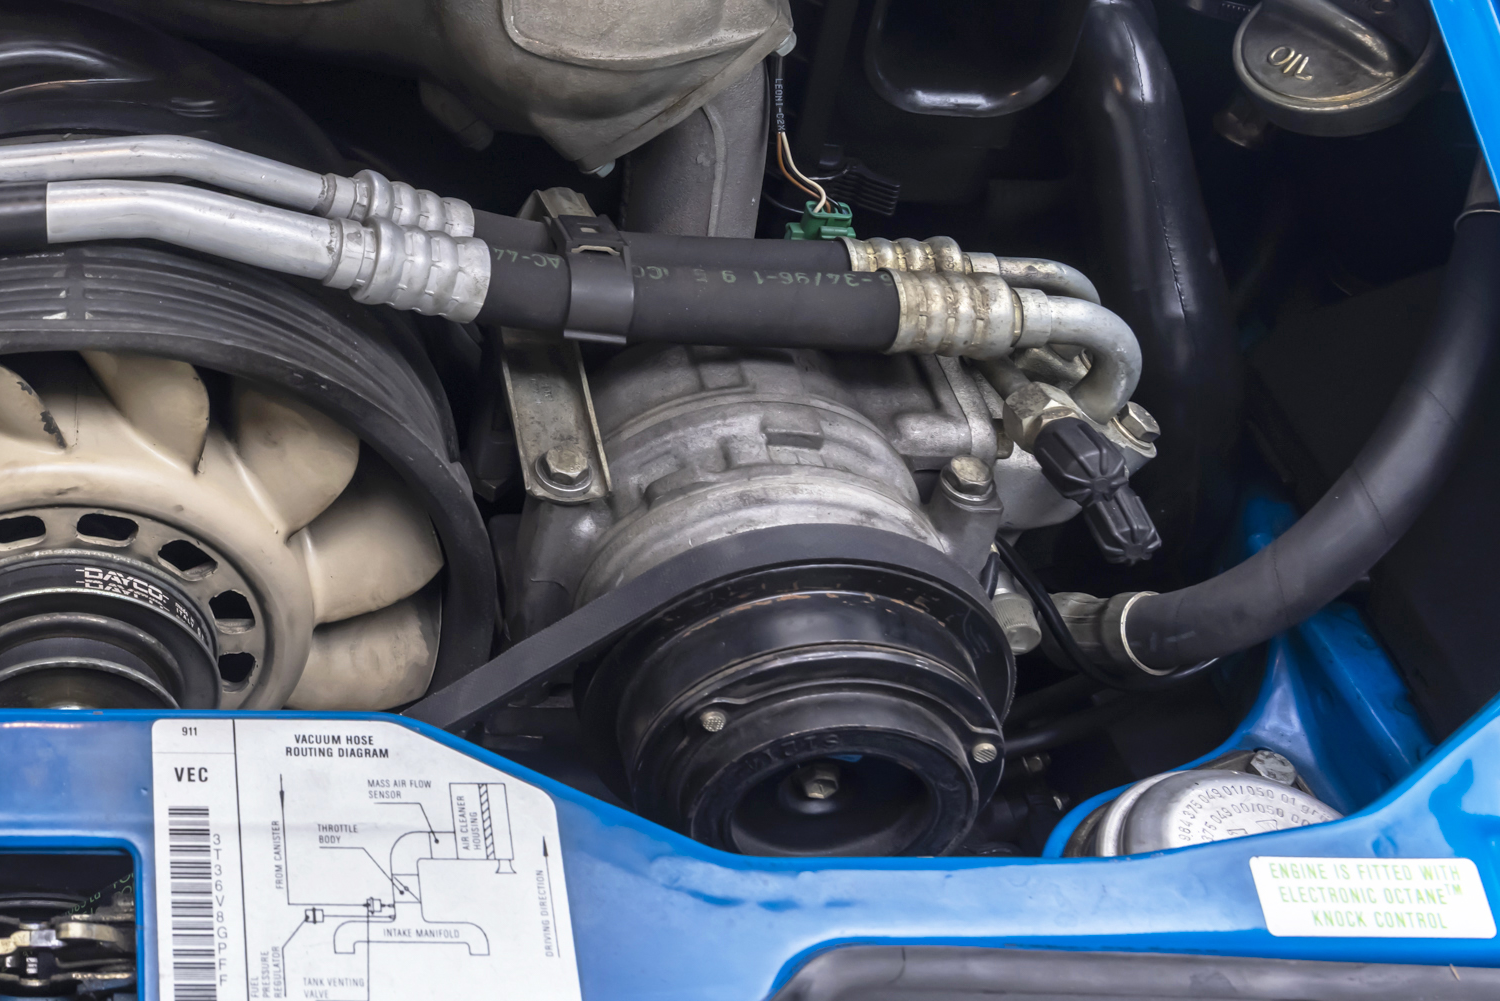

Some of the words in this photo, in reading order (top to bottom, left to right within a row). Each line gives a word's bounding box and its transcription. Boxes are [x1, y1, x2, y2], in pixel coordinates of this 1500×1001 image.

[1267, 46, 1313, 81] OIL
[84, 567, 164, 602] DAYCO
[181, 726, 198, 736] 911
[294, 734, 341, 745] VACUUM
[346, 735, 374, 746] HOSE
[285, 747, 333, 758] ROUTING
[338, 748, 389, 758] DIAGRAM
[174, 767, 208, 783] VEC
[367, 779, 390, 788] MASS
[393, 780, 407, 788] AIR
[409, 780, 432, 788] FLOW
[368, 790, 402, 799] SENSOR
[457, 795, 469, 836] CLEANER
[317, 824, 358, 833] THROTTLE
[469, 811, 481, 850] HOUSING
[271, 820, 282, 861] CANISTER
[319, 835, 341, 844] BODY
[461, 837, 470, 851] AIR
[276, 865, 284, 889] FROM
[1268, 862, 1328, 880] ENGINE
[1333, 863, 1350, 880] IS
[1356, 864, 1413, 881] FITTED
[1417, 864, 1461, 881] WITH
[536, 870, 549, 917] DIRECTION
[1278, 886, 1377, 904] ELECTRONIC
[1311, 910, 1367, 928] KNOCK
[1374, 911, 1448, 929] CONTROL
[383, 928, 412, 937] INTAKE
[415, 929, 460, 938] MANIFOLD
[541, 920, 554, 957] DRIVING
[260, 951, 271, 998] PRESSURE
[272, 946, 282, 998] REGULATOR
[251, 976, 259, 998] FUEL
[303, 977, 324, 986] TANK
[327, 978, 365, 987] VENTING
[304, 989, 329, 998] VALVE
